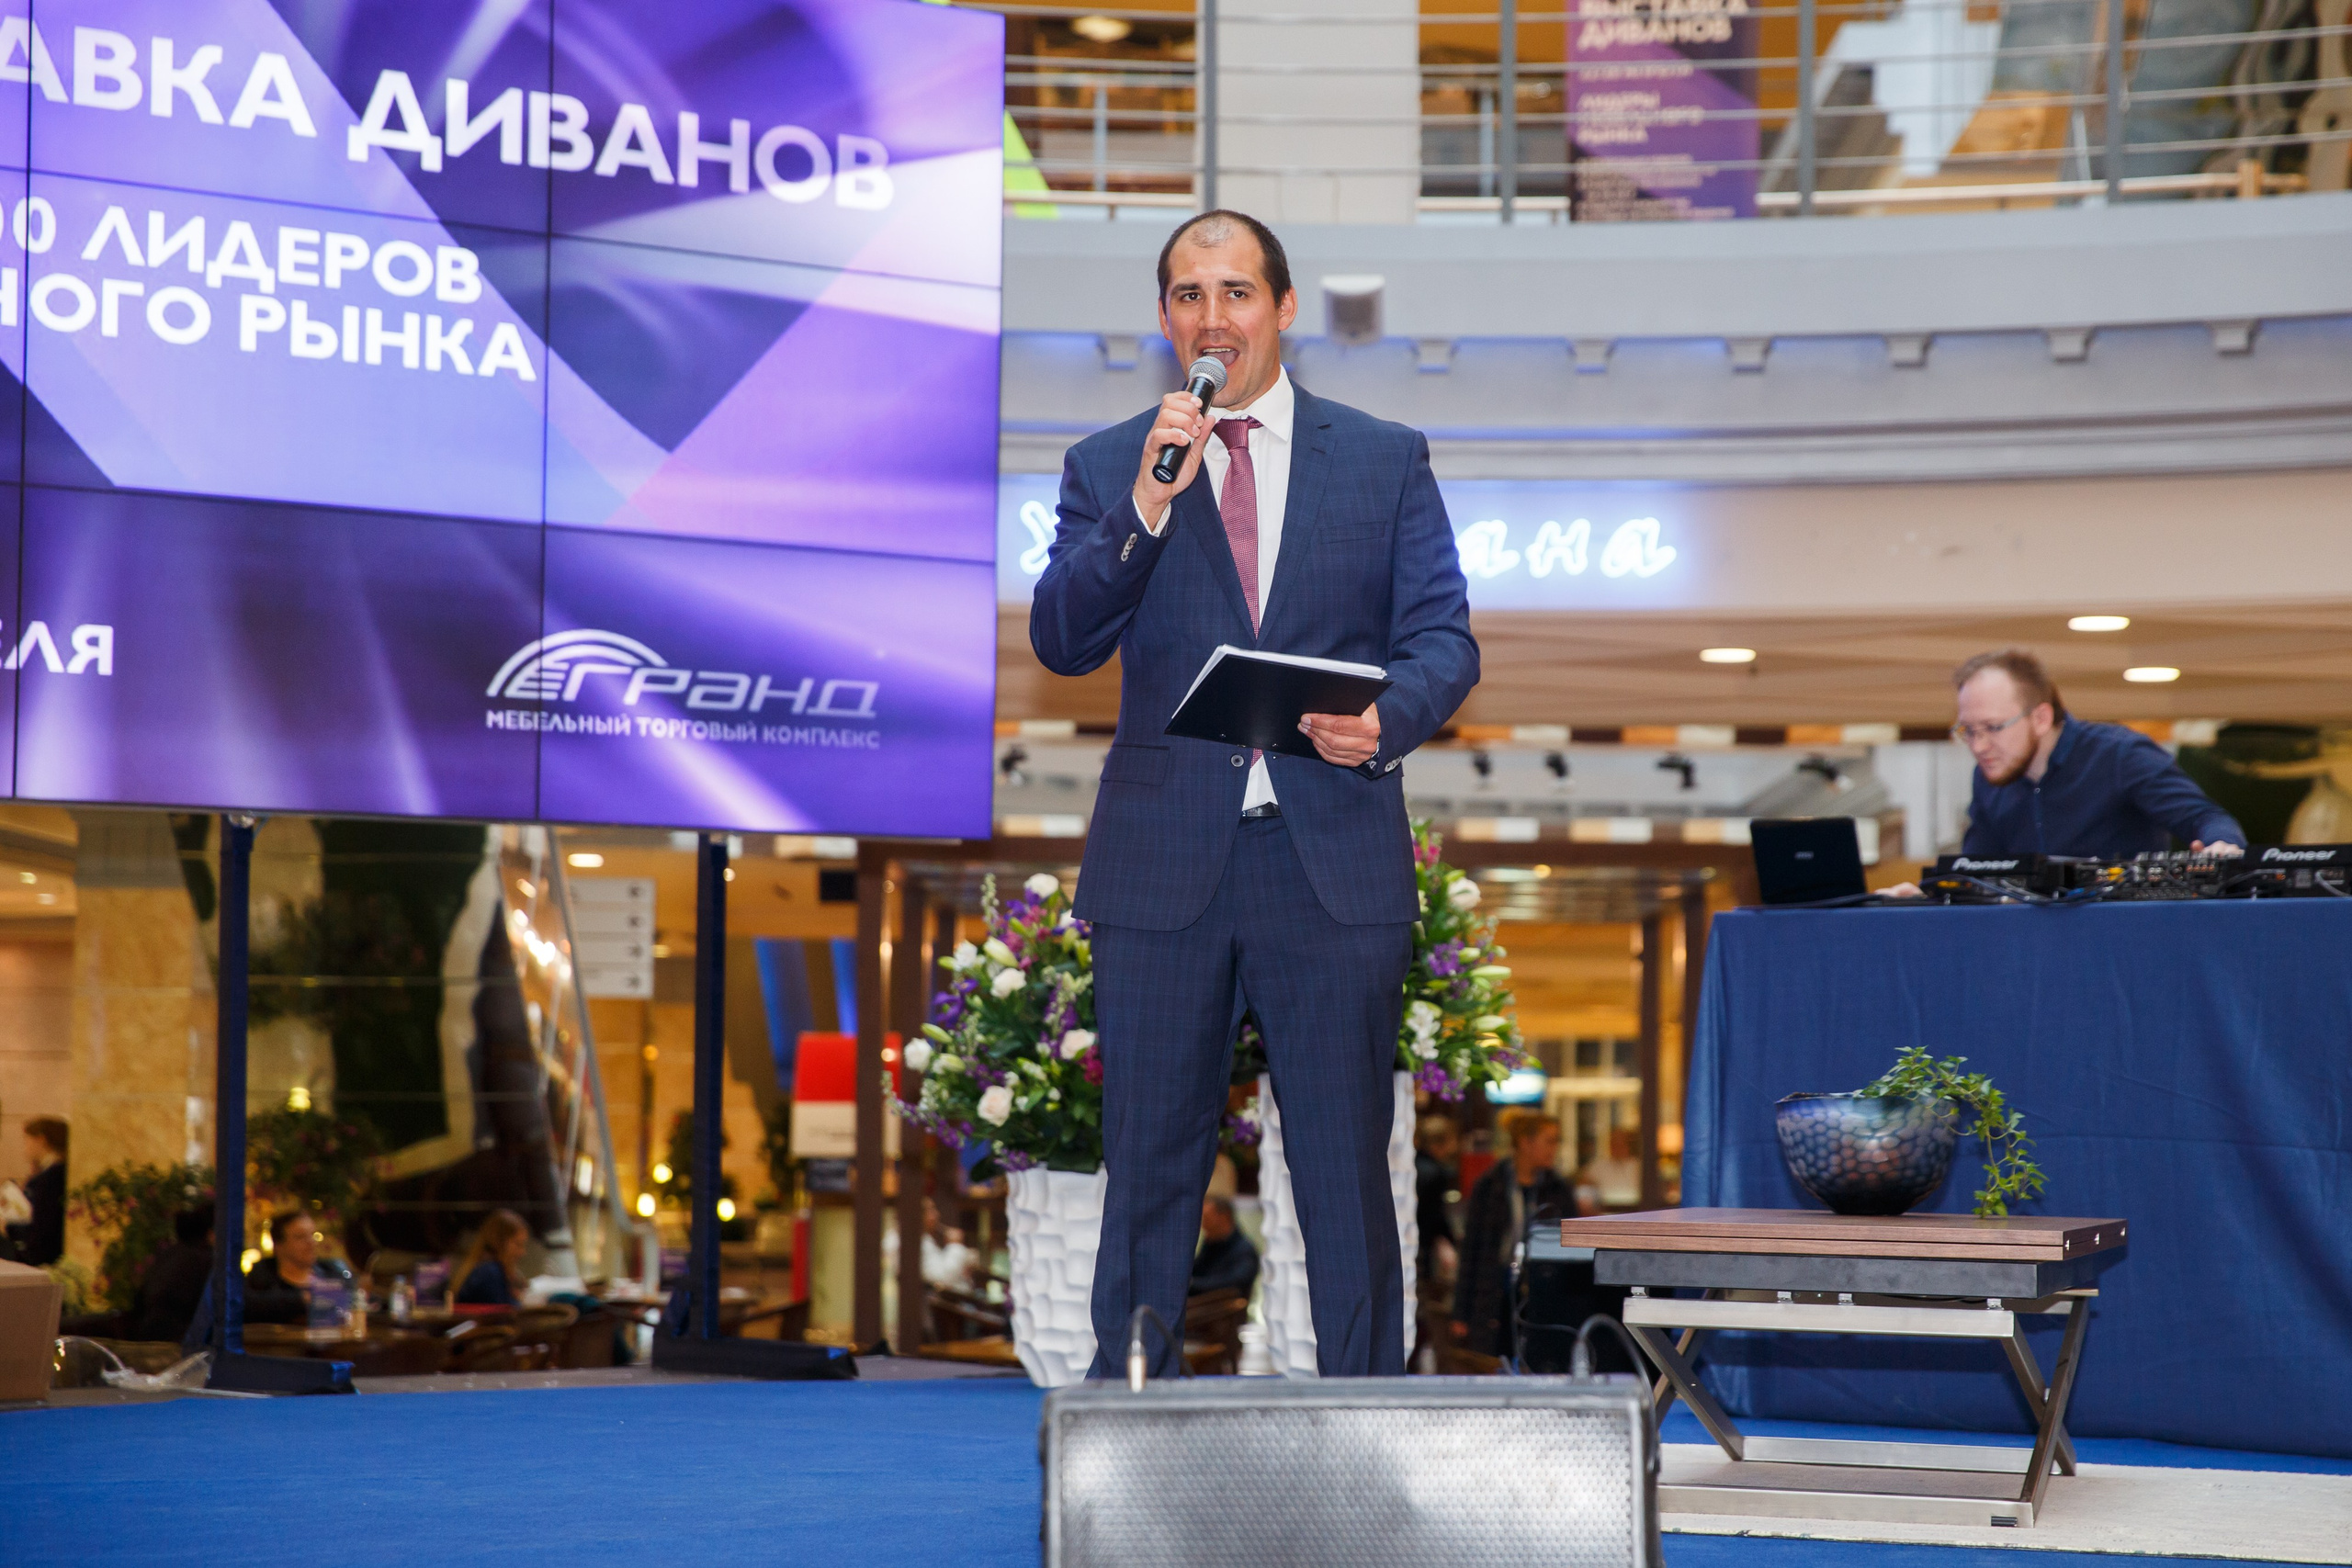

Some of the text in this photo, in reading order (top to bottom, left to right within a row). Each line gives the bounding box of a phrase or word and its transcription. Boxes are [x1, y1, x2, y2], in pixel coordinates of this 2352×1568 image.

[346, 68, 895, 211] ДИВАНОВ
[0, 195, 483, 305] 0 ЛИДЕРОВ
[239, 293, 537, 382] РЫНКА
[1455, 516, 1678, 579] ана
[0, 619, 114, 677] ЛЯ
[486, 710, 880, 750] МЕБЕЛЬНЫЙ ТОРГОВЫЙ КОМПЛЕКС
[1951, 856, 2020, 872] Pioneer
[2261, 847, 2337, 863] Pioneer
